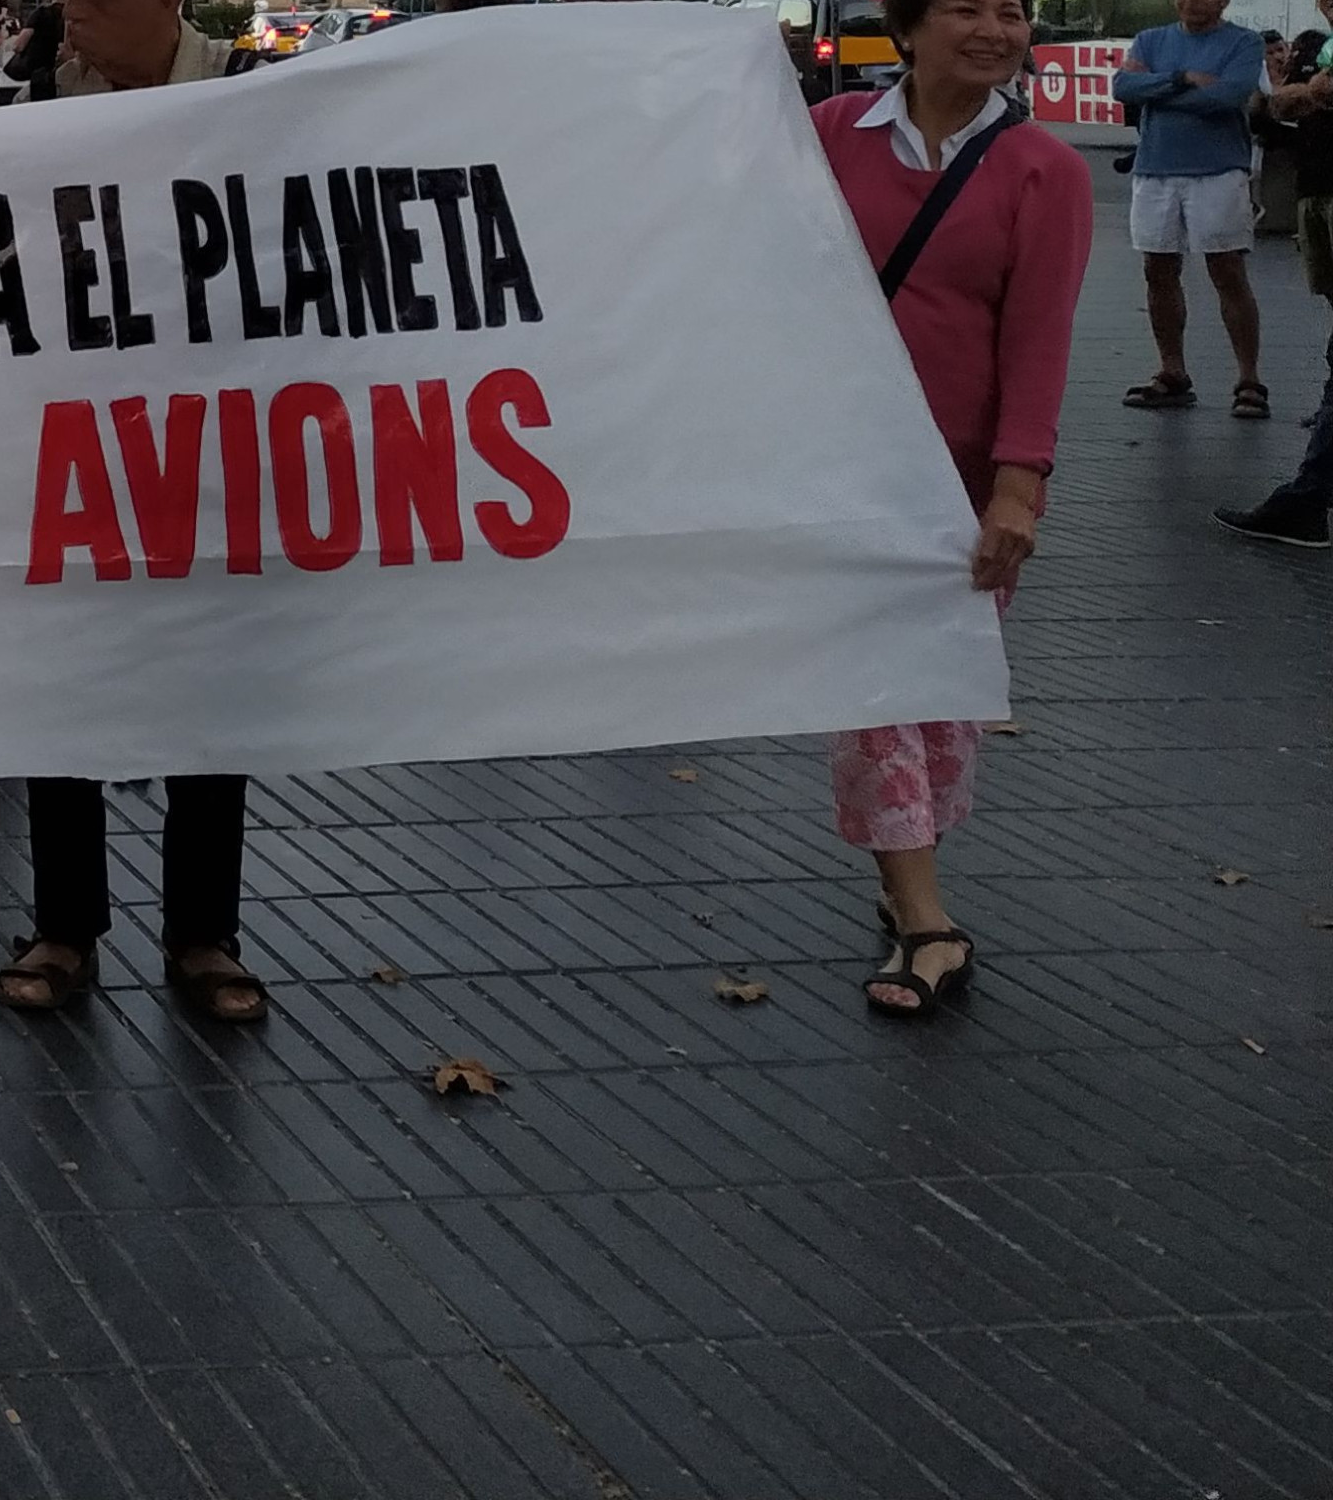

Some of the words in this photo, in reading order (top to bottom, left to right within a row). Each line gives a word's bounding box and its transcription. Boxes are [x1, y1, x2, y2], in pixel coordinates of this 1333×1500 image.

[53, 183, 155, 351] EL
[172, 164, 544, 344] PLANETA
[25, 367, 571, 585] AVIONS
